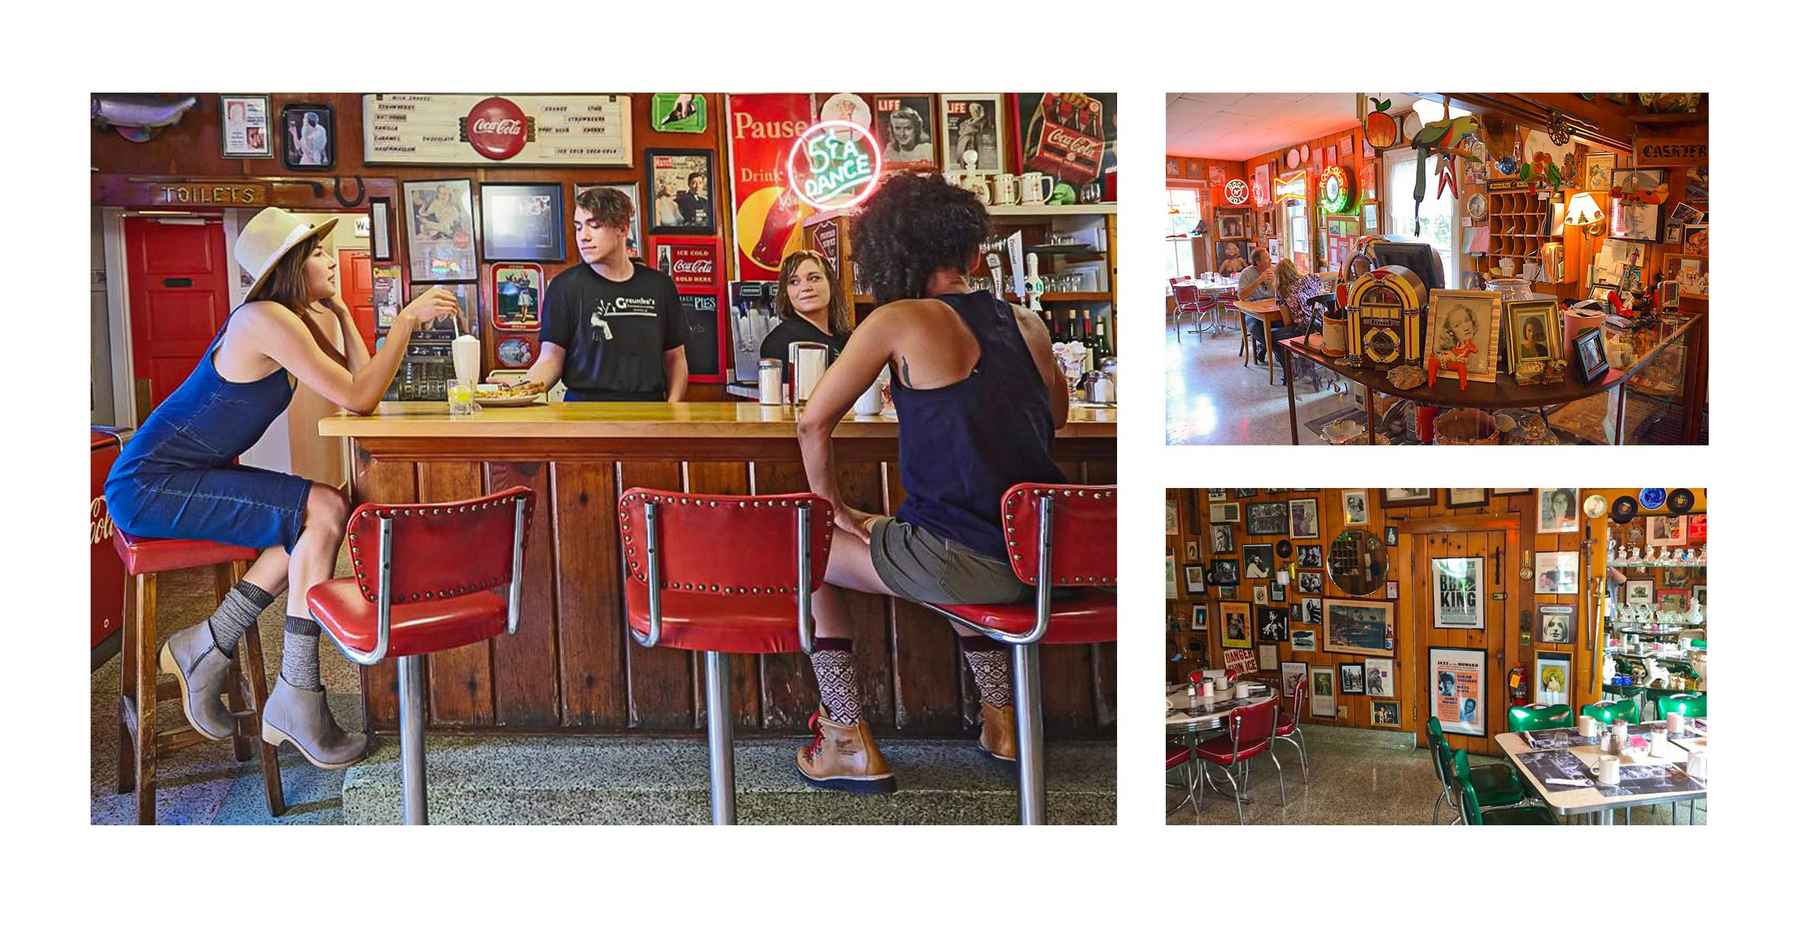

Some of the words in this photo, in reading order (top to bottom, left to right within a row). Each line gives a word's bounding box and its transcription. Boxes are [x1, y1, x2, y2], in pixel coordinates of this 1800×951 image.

[878, 99, 901, 111] LIFE
[734, 111, 808, 140] Pause
[741, 167, 783, 184] Drink
[804, 153, 872, 199] DANCE
[163, 186, 255, 203] TOILETS
[694, 296, 717, 310] PIES
[1440, 591, 1476, 608] KING
